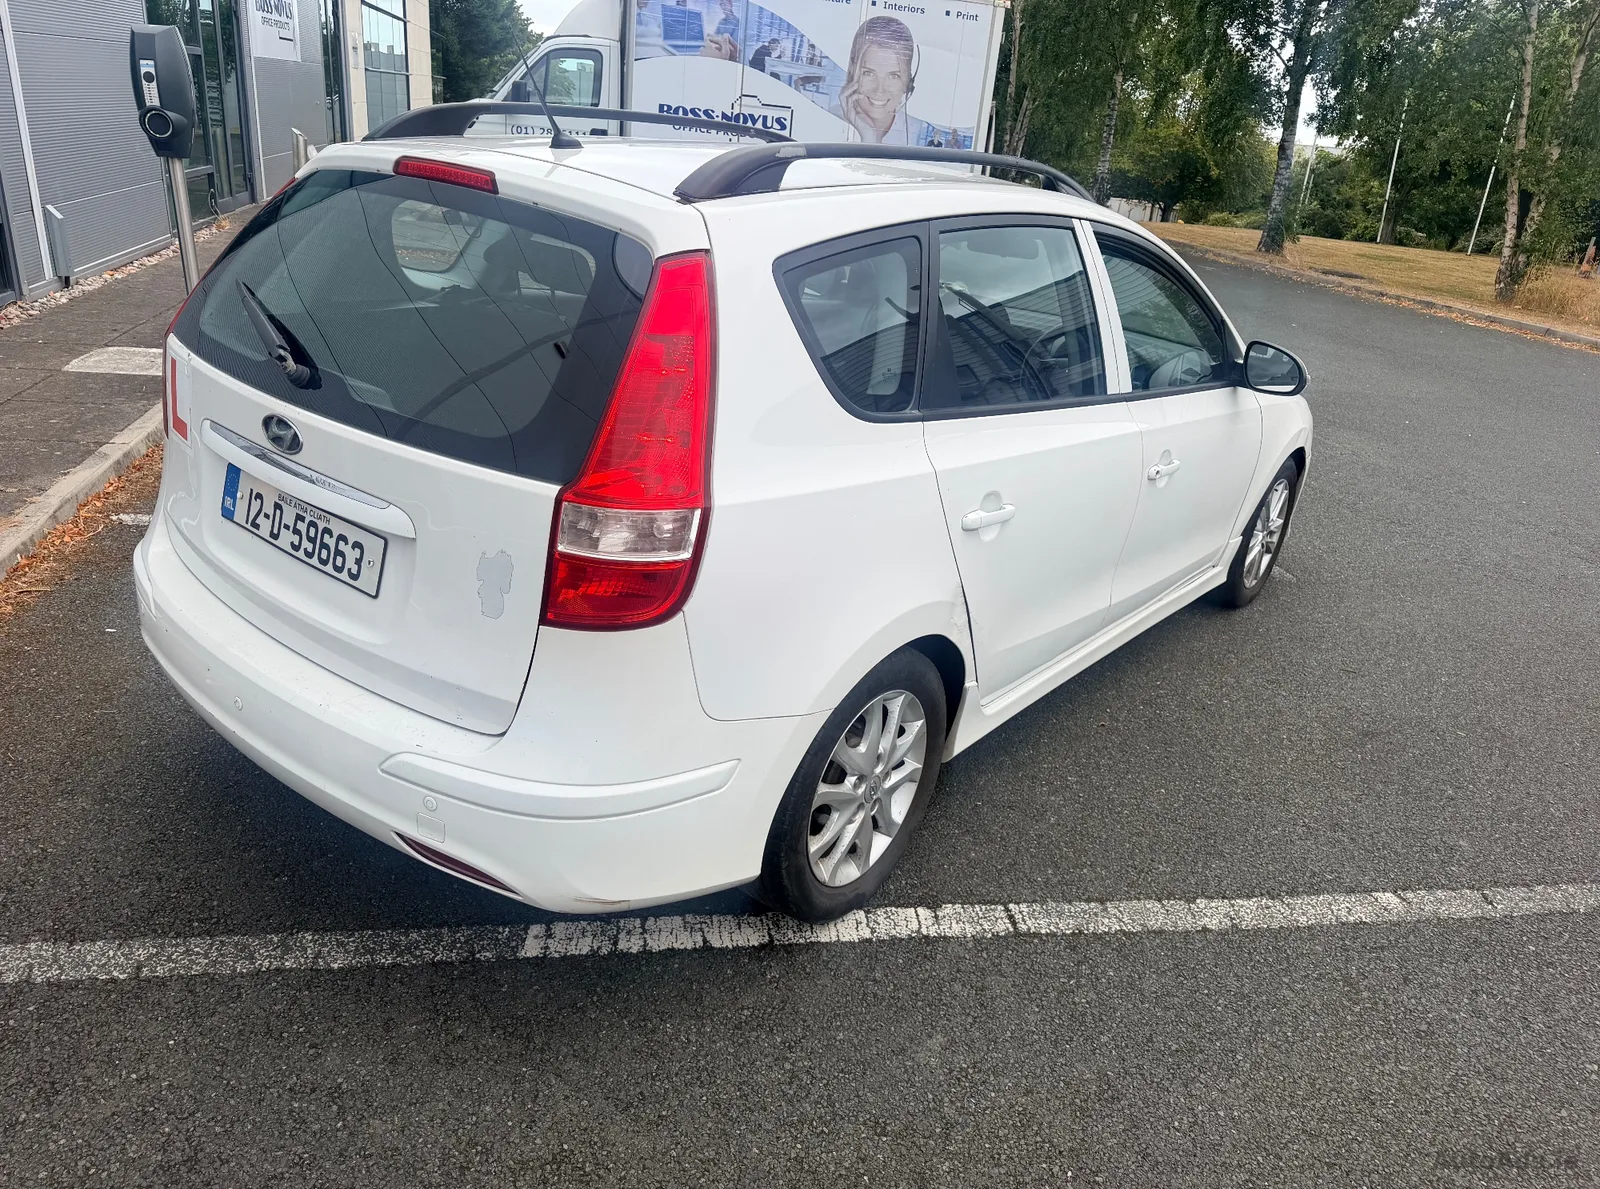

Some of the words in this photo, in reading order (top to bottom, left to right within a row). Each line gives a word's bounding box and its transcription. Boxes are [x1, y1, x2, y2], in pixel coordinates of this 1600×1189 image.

[883, 1, 926, 15] Interiors
[956, 11, 979, 22] Print
[510, 125, 535, 135] (01)
[171, 356, 188, 441] L
[278, 493, 293, 508] BAILE
[309, 509, 331, 526] CLIATH
[245, 488, 365, 582] 12-D-59663
